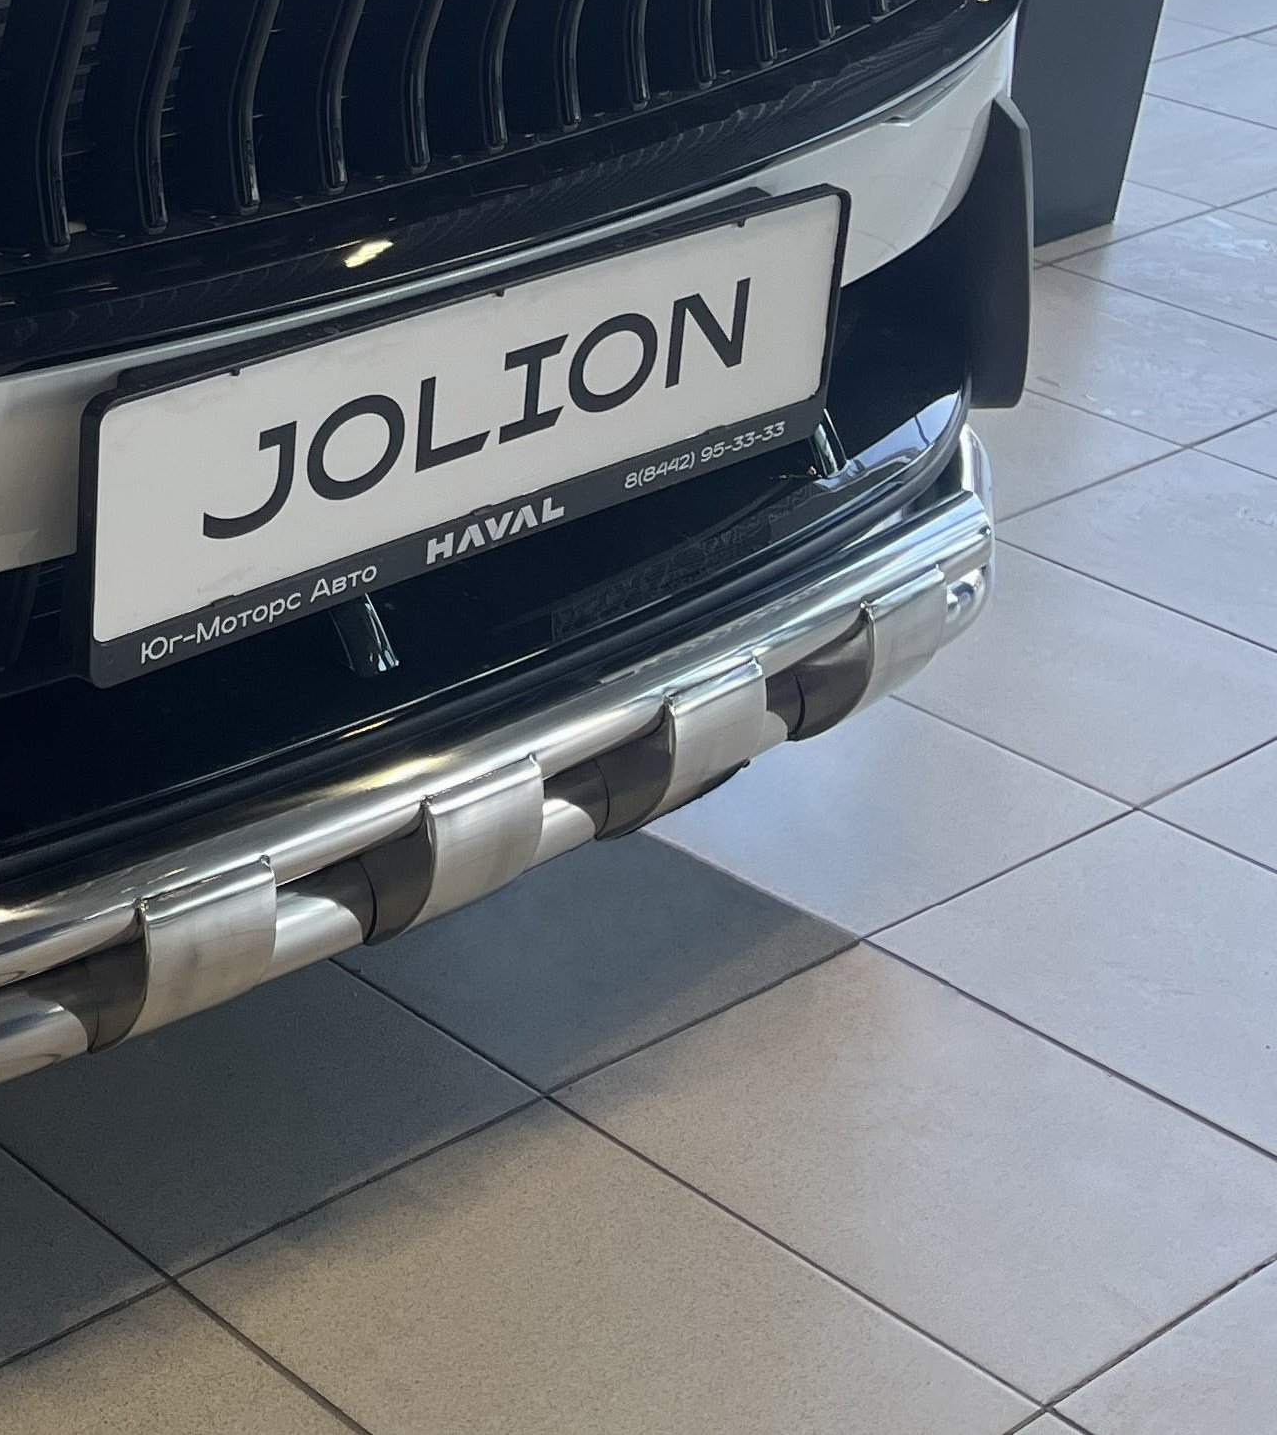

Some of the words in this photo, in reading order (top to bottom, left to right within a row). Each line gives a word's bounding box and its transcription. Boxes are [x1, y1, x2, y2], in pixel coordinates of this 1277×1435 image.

[202, 277, 752, 540] JOLION
[623, 451, 696, 490] 8(8442)
[700, 420, 786, 463] 95-33-33
[425, 496, 565, 565] HAVAL
[140, 591, 302, 665] Юг-Моторс
[309, 564, 378, 603] Авто
